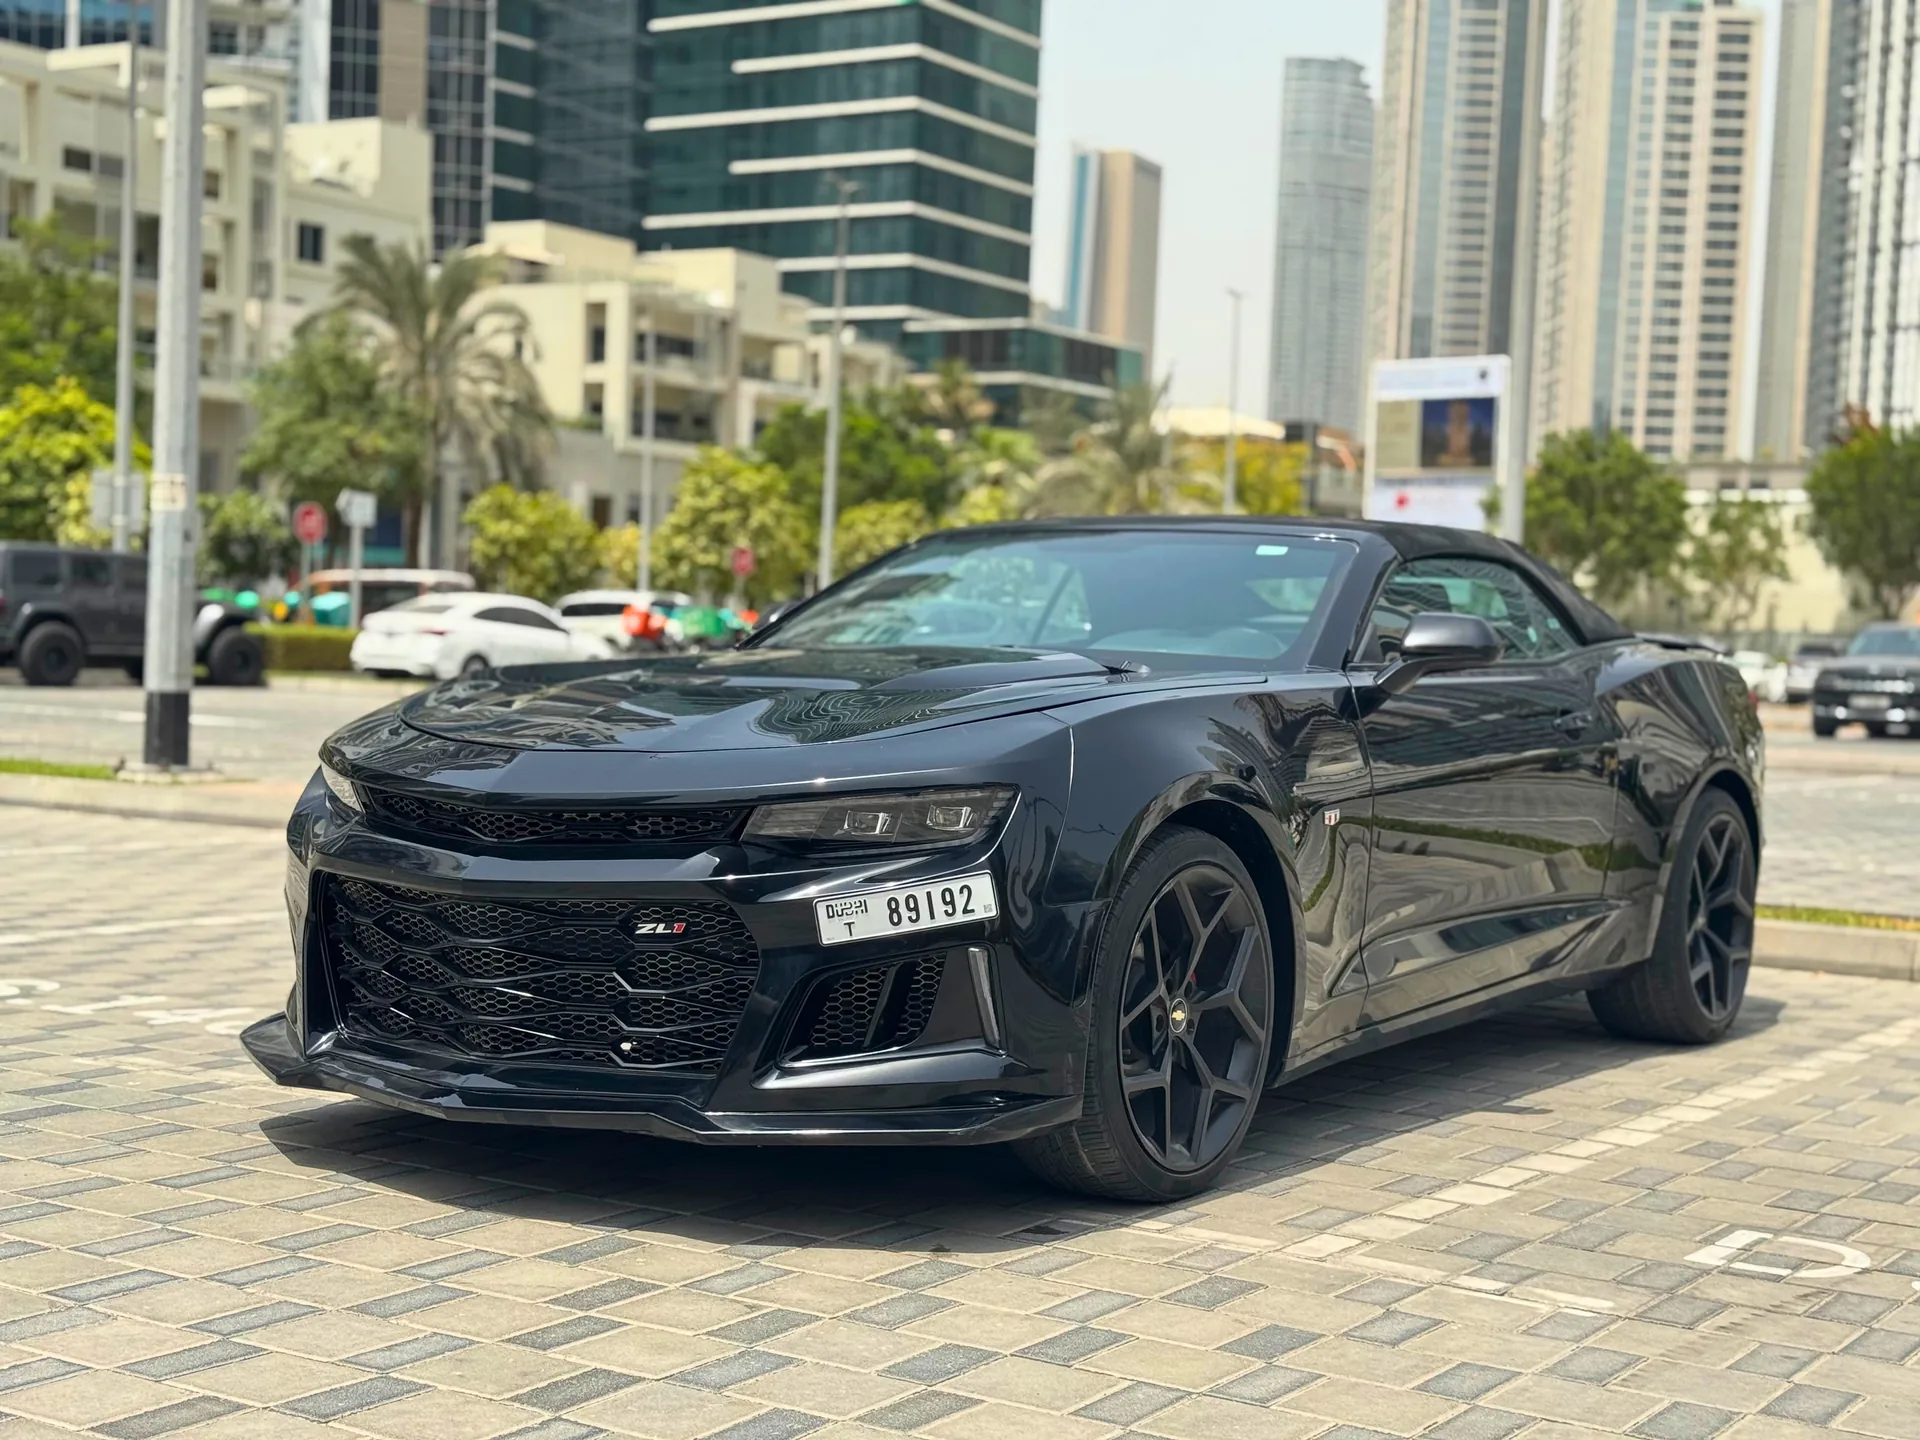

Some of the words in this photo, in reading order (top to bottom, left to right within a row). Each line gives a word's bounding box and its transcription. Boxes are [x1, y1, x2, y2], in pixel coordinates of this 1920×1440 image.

[886, 884, 976, 927] 89192
[635, 922, 687, 934] ZL1
[843, 921, 856, 937] T
